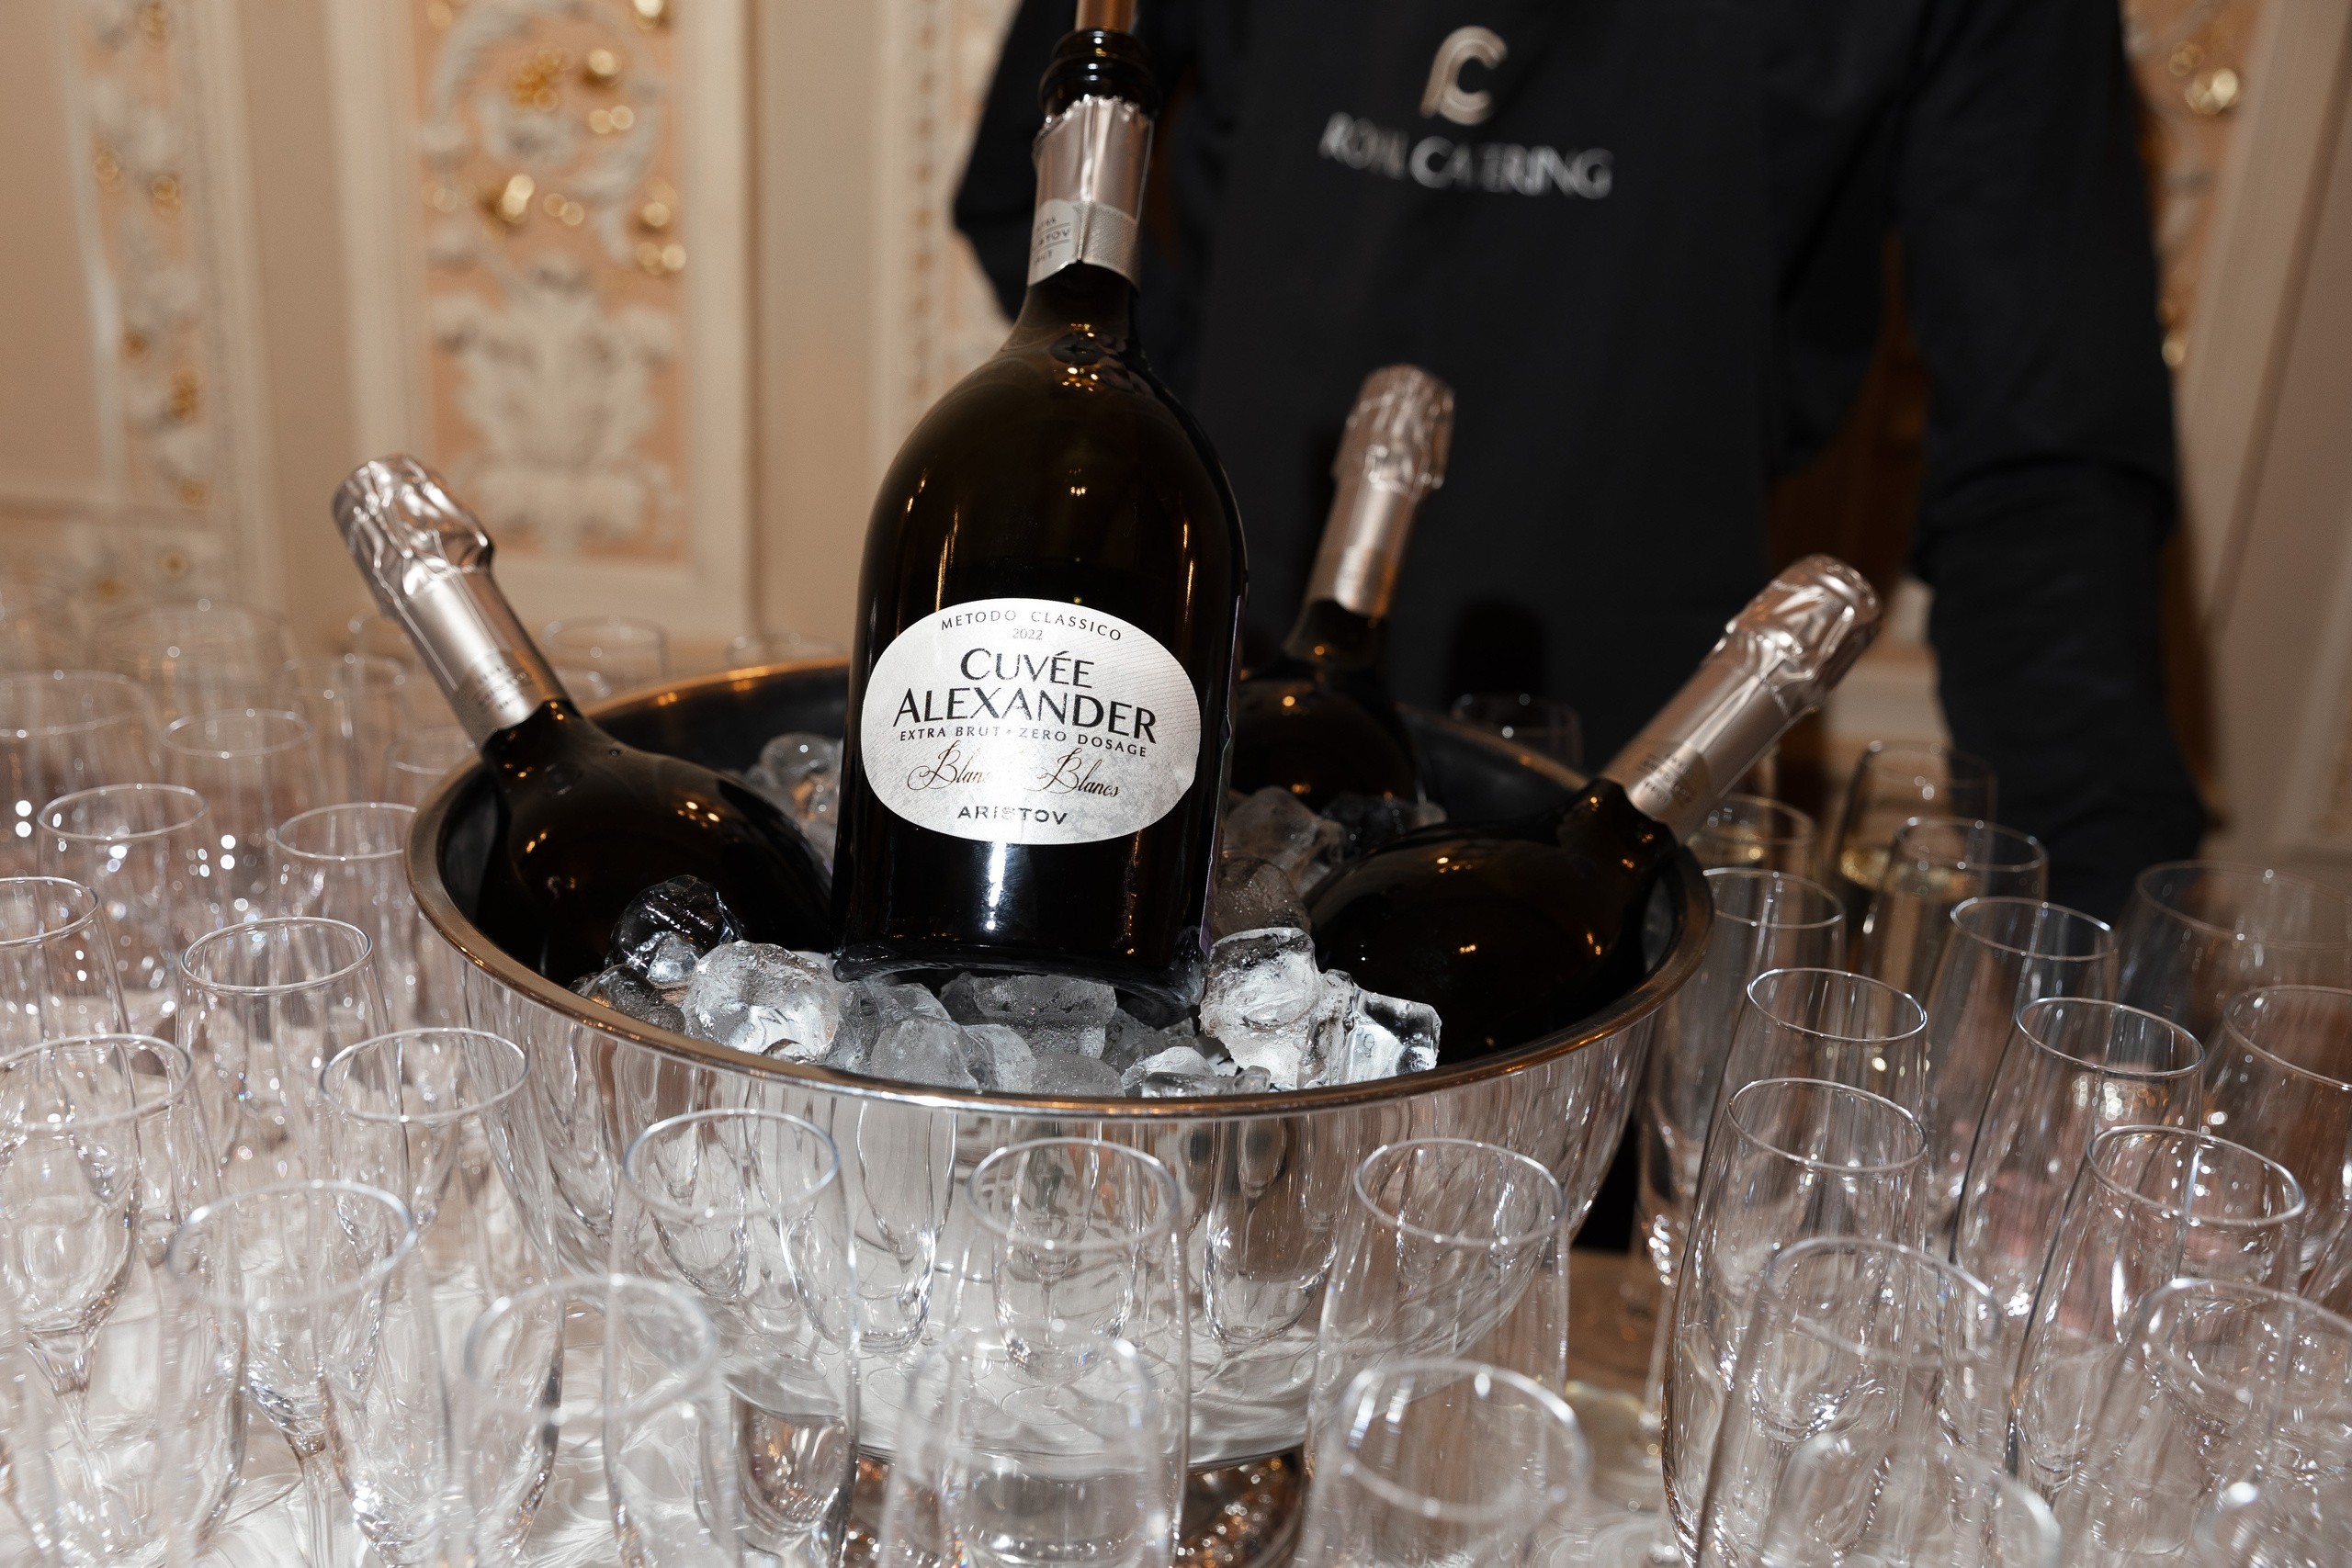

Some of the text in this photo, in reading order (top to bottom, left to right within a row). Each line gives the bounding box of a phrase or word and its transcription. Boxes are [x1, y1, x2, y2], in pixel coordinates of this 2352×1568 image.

[941, 609, 1122, 641] METODO CLASSICO
[1012, 627, 1044, 641] 2022
[893, 686, 1157, 745] ALEXANDER
[899, 725, 1147, 758] EXTRA BRUT ZERO DOSAGE
[906, 739, 1121, 798] Blan Blancs
[956, 805, 1068, 826] ARISTOV
